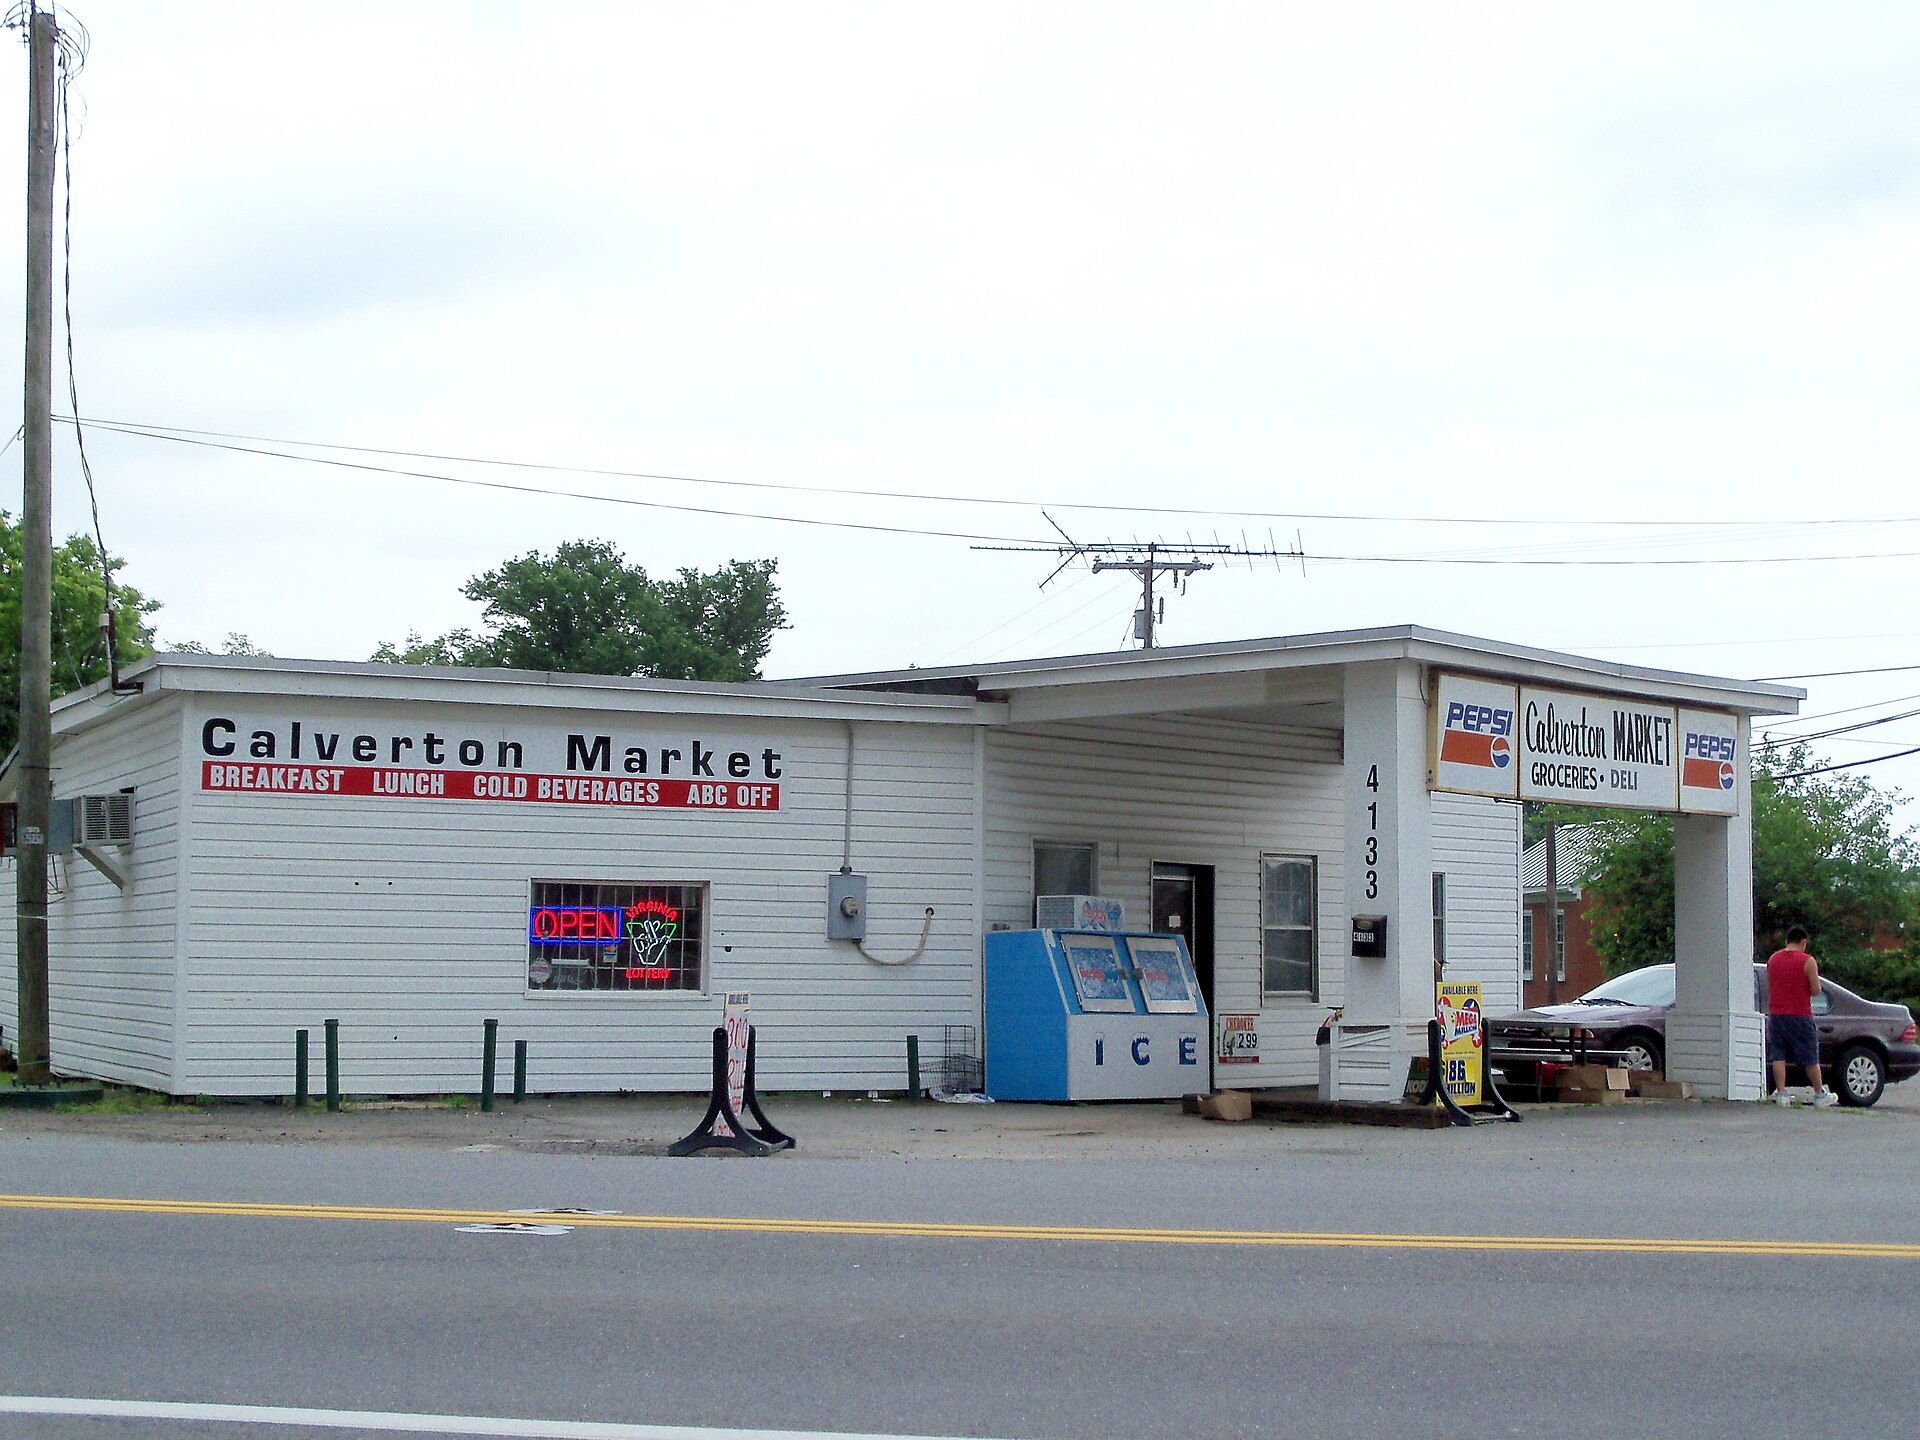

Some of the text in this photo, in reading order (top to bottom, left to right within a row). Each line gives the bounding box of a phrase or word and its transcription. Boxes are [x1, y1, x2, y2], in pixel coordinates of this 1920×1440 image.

[1446, 701, 1513, 736] PEPSI
[1525, 700, 1672, 766] Calverton MARKET
[202, 717, 782, 779] Calverton Market
[1685, 732, 1736, 761] PEPSI
[210, 765, 773, 807] BREAKFAST LUNCH COLD BEVERAGES ABC OFF
[1531, 762, 1638, 791] GROCERIES DELI
[1365, 764, 1379, 899] 4133
[534, 910, 619, 938] OPEN
[626, 901, 678, 921] VIRGINIA
[626, 967, 671, 979] LOTTERY
[1442, 985, 1478, 995] AVAILABLE HERE
[1456, 1010, 1477, 1027] MEGA
